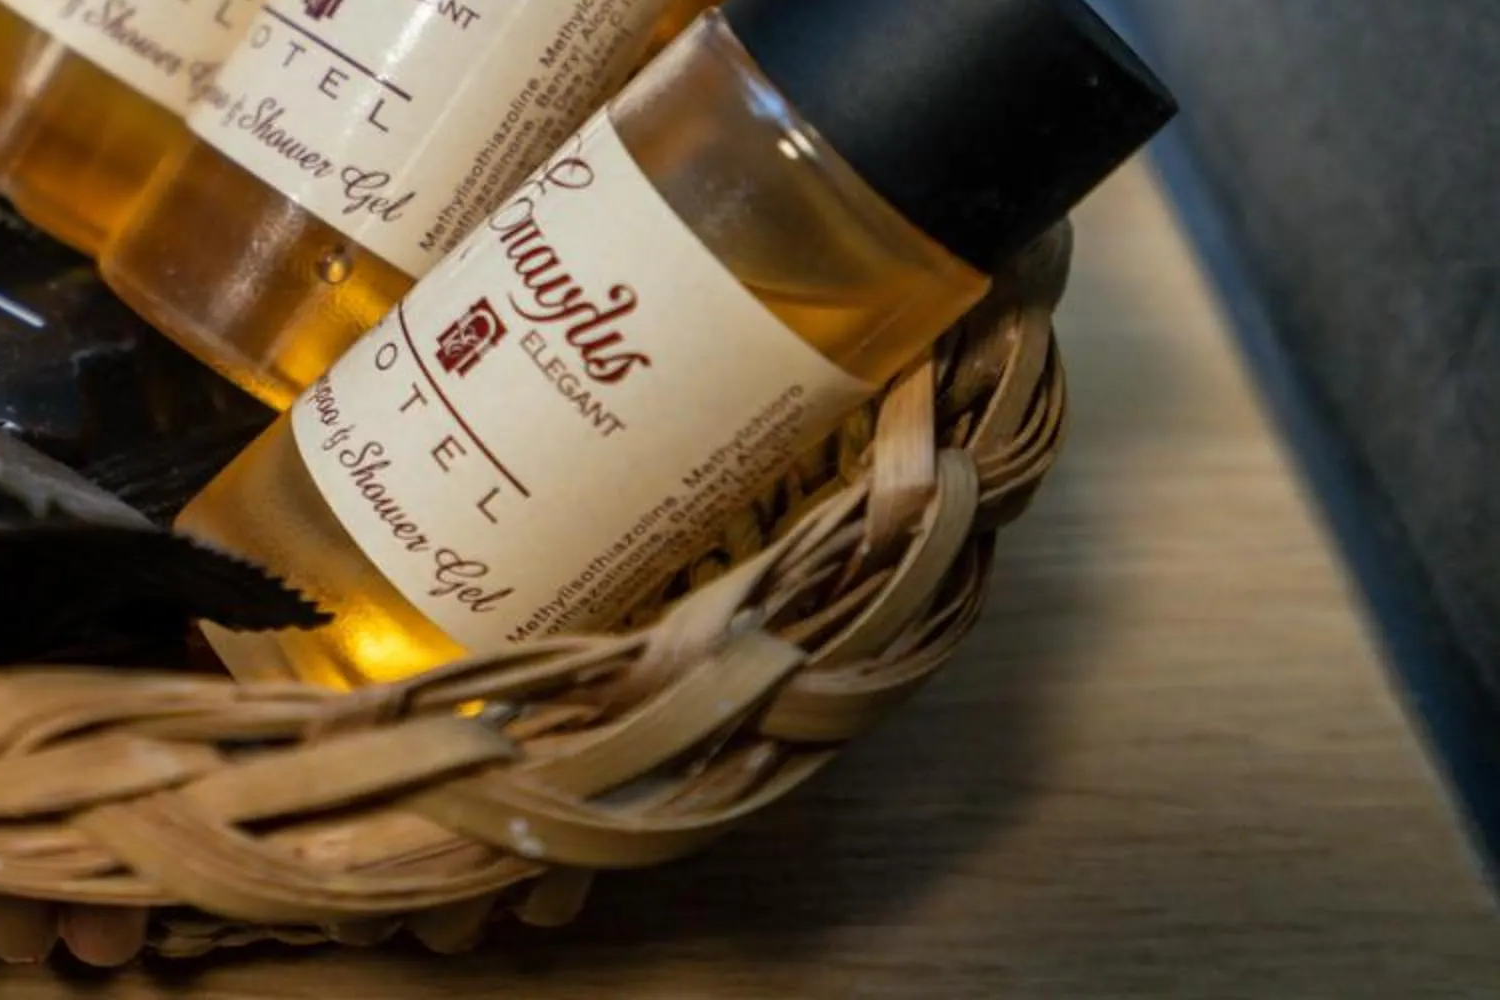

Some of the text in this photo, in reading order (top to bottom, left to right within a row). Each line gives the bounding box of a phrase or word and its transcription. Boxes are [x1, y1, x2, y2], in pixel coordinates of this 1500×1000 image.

[251, 24, 389, 133] OTEL
[238, 96, 334, 178] Shower
[341, 165, 416, 222] Gel
[375, 342, 500, 525] OTEL
[520, 329, 627, 439] ELEGANT
[339, 441, 429, 552] Shower
[428, 548, 515, 613] Gel
